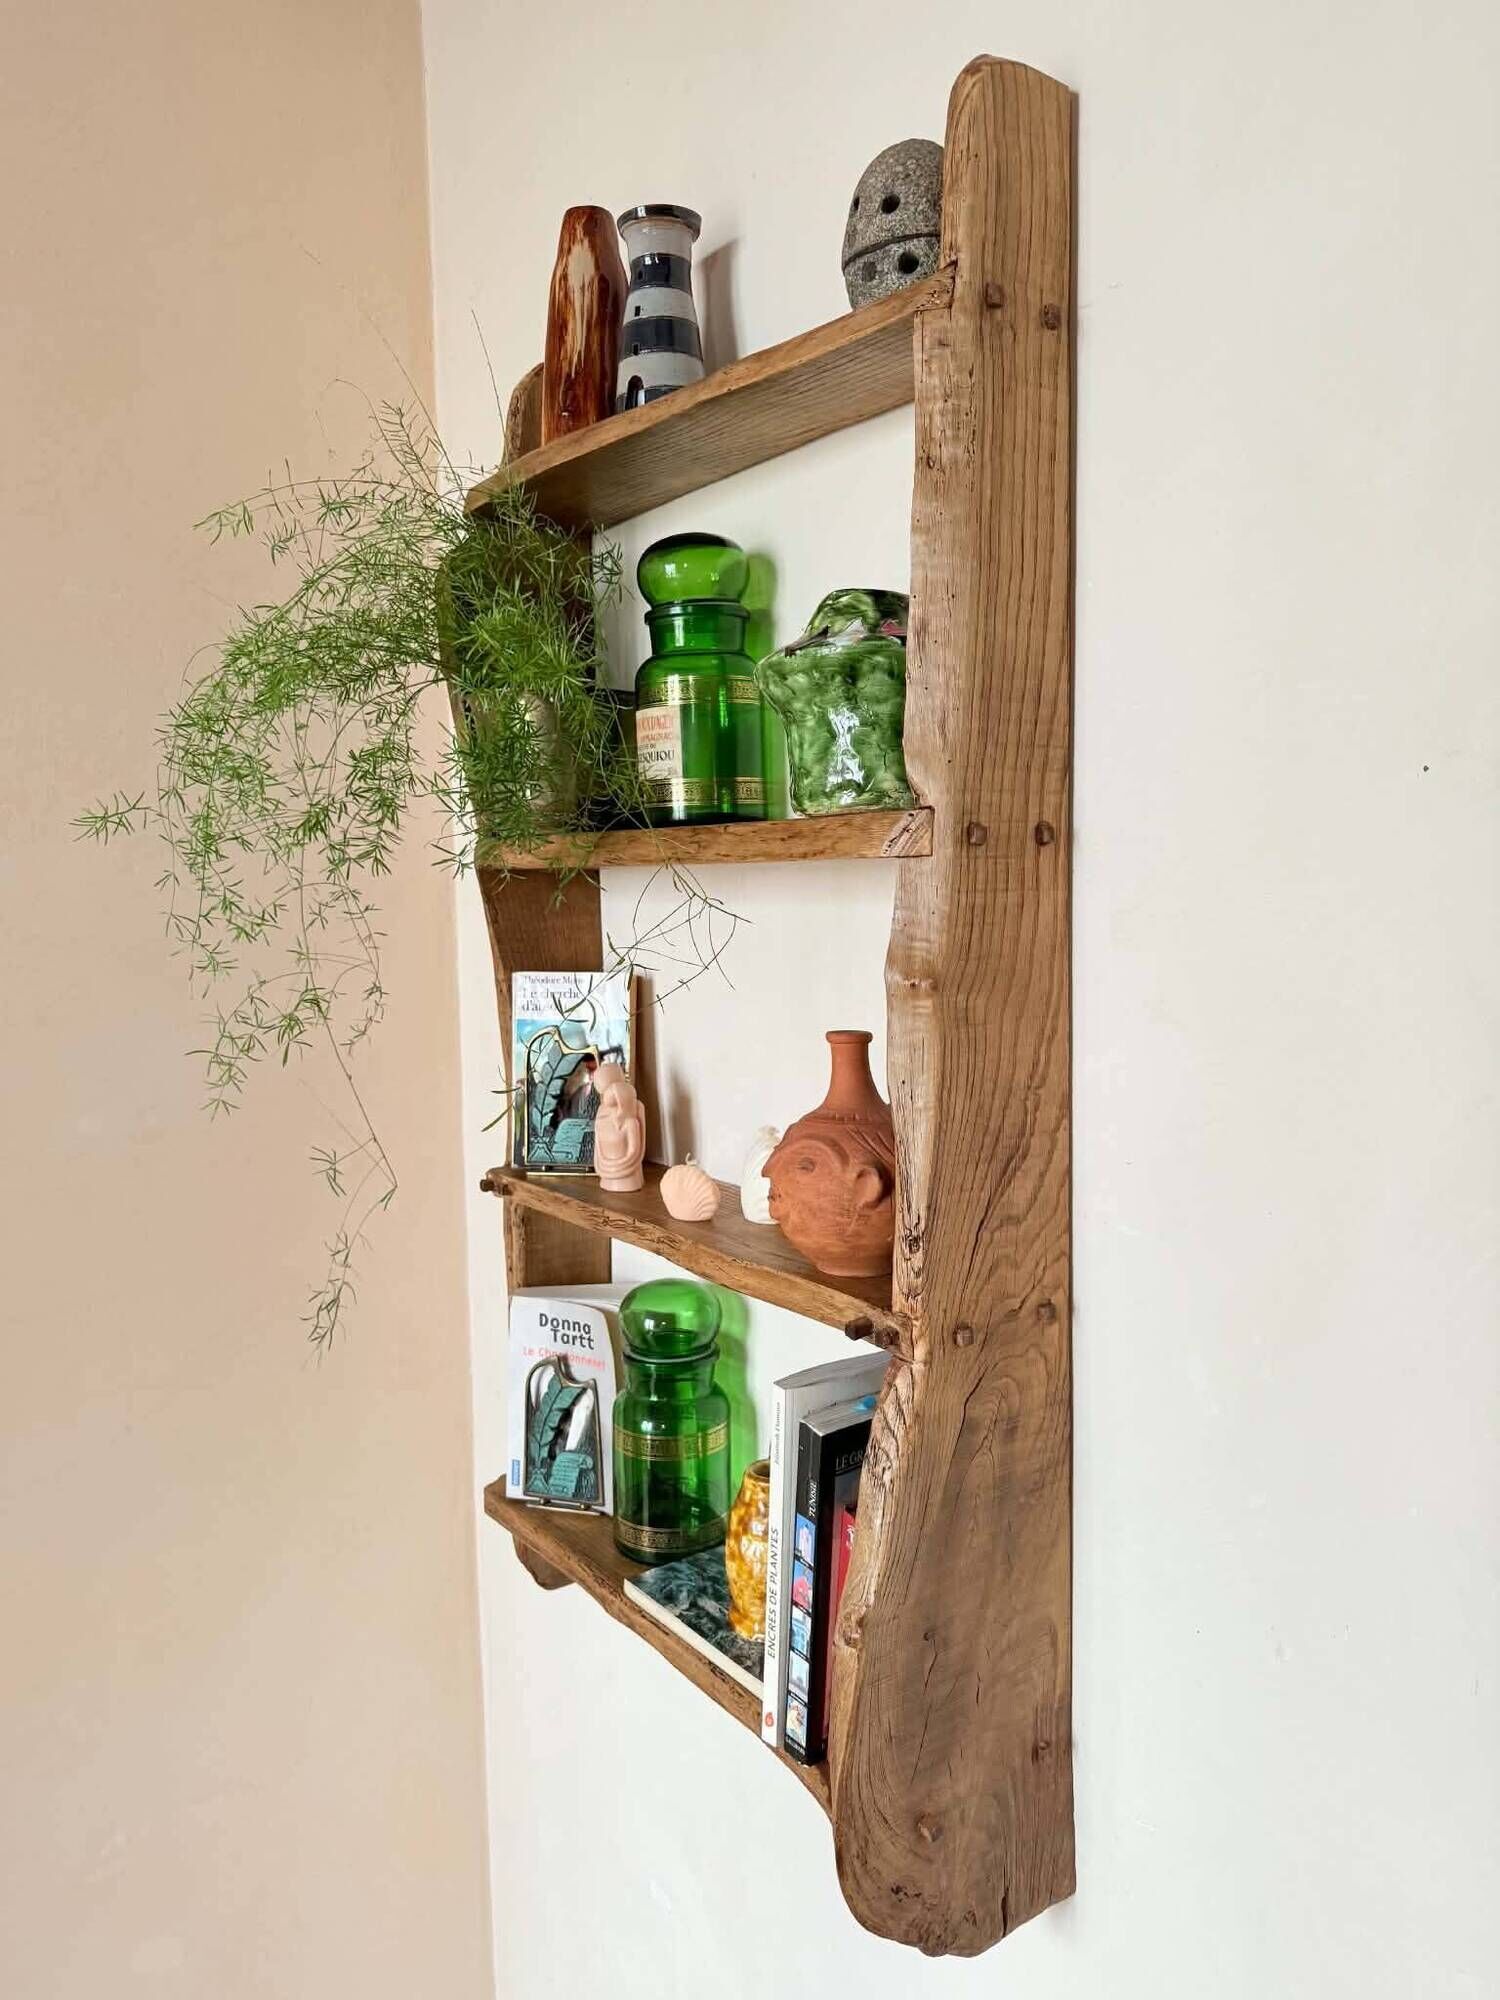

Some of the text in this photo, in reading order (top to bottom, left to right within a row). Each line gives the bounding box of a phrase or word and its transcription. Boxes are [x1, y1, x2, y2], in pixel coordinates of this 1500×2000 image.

[539, 1312, 591, 1335] Donna
[550, 1328, 594, 1350] Tartt
[522, 1346, 534, 1356] Le
[767, 1527, 779, 1659] ENCRES DE PLANTES
